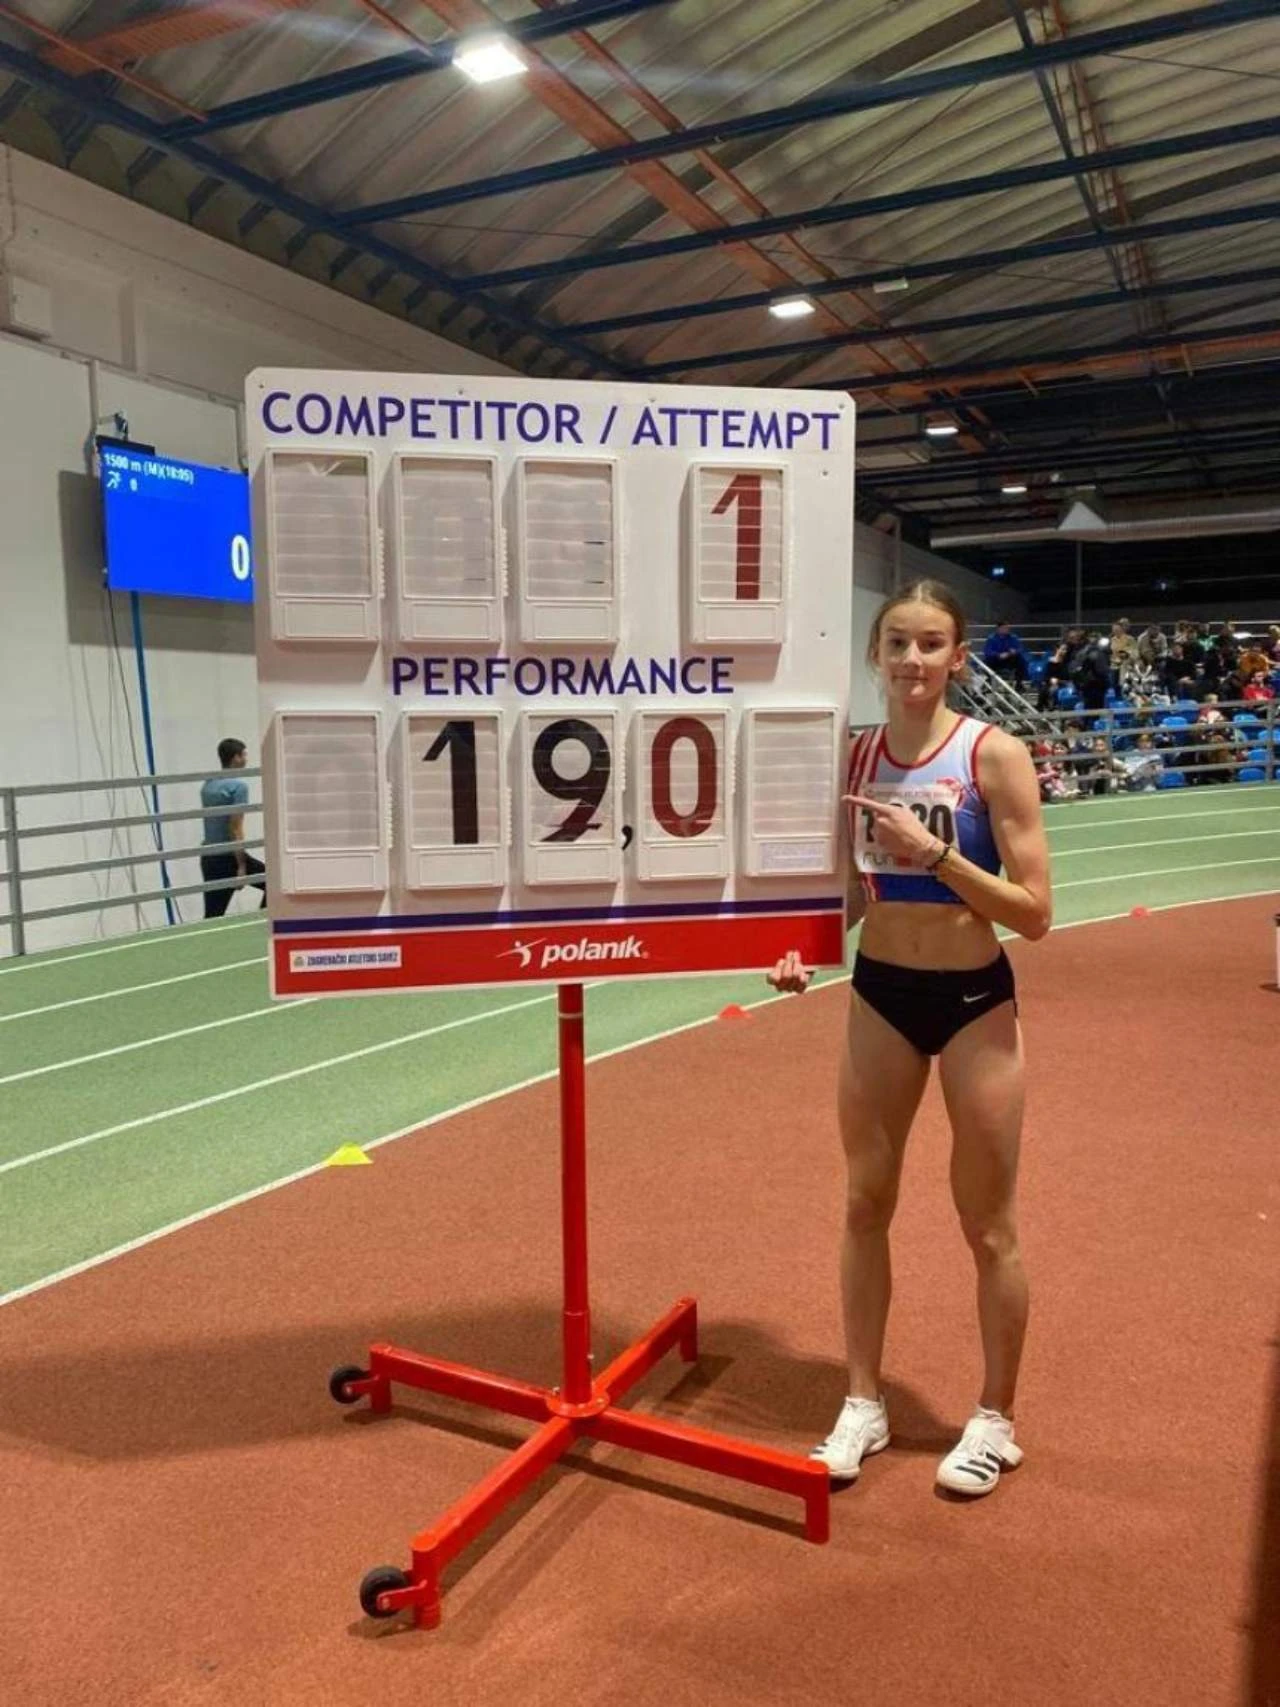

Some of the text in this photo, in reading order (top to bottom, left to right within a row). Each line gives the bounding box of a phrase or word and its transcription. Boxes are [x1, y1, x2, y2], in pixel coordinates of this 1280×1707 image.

[263, 392, 583, 444] COMPETITOR
[631, 407, 841, 450] ATTEMPT
[711, 473, 764, 601] 1
[392, 656, 735, 696] PERFORMANCE
[540, 935, 643, 969] polanik
